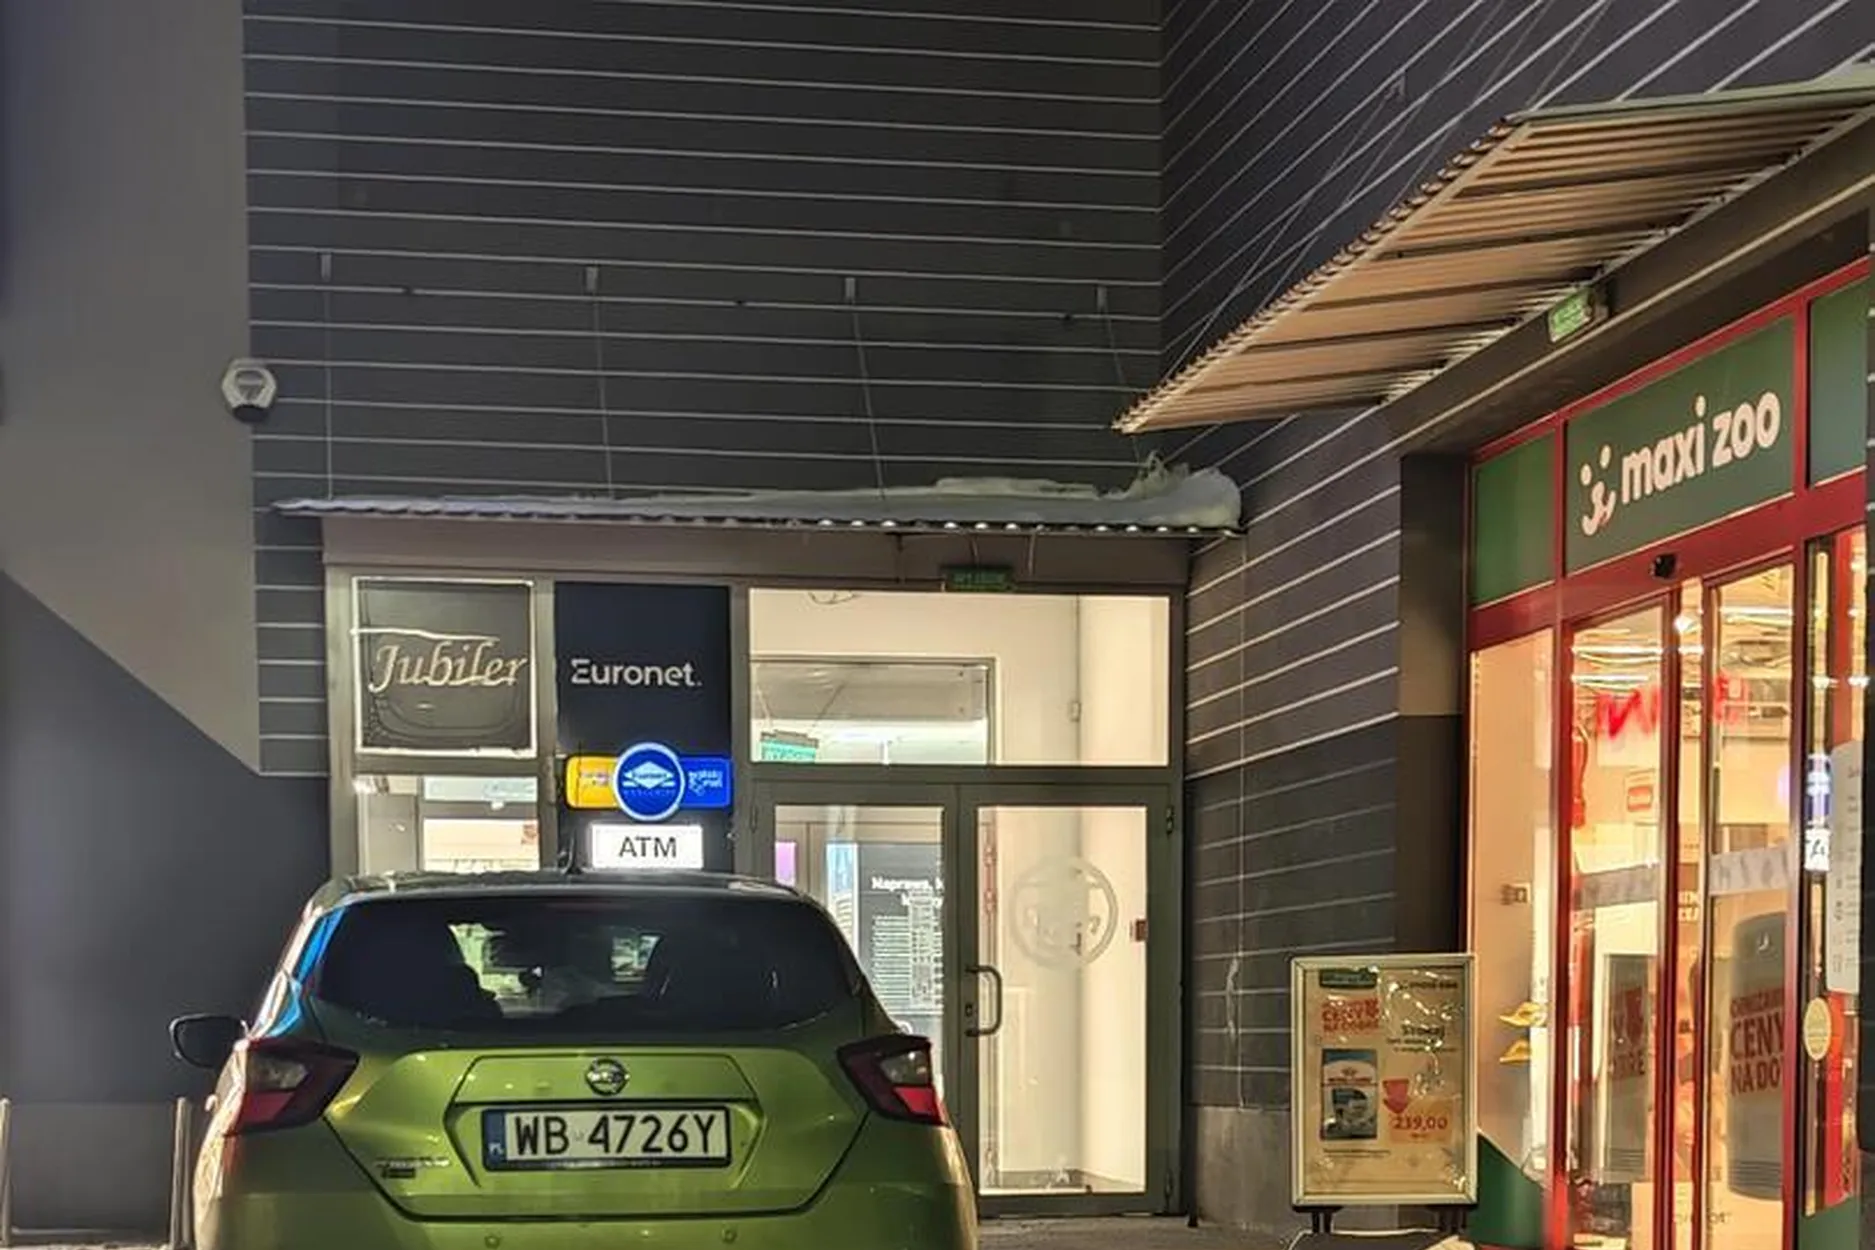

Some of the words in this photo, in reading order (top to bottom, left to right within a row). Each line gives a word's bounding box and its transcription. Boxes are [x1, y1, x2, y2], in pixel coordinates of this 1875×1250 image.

[1621, 395, 1705, 504] maxi
[1712, 391, 1782, 467] zoo
[367, 640, 528, 693] Jubiler
[618, 836, 677, 858] ATM
[515, 1115, 570, 1156] WB
[588, 1114, 716, 1154] 4726Y
